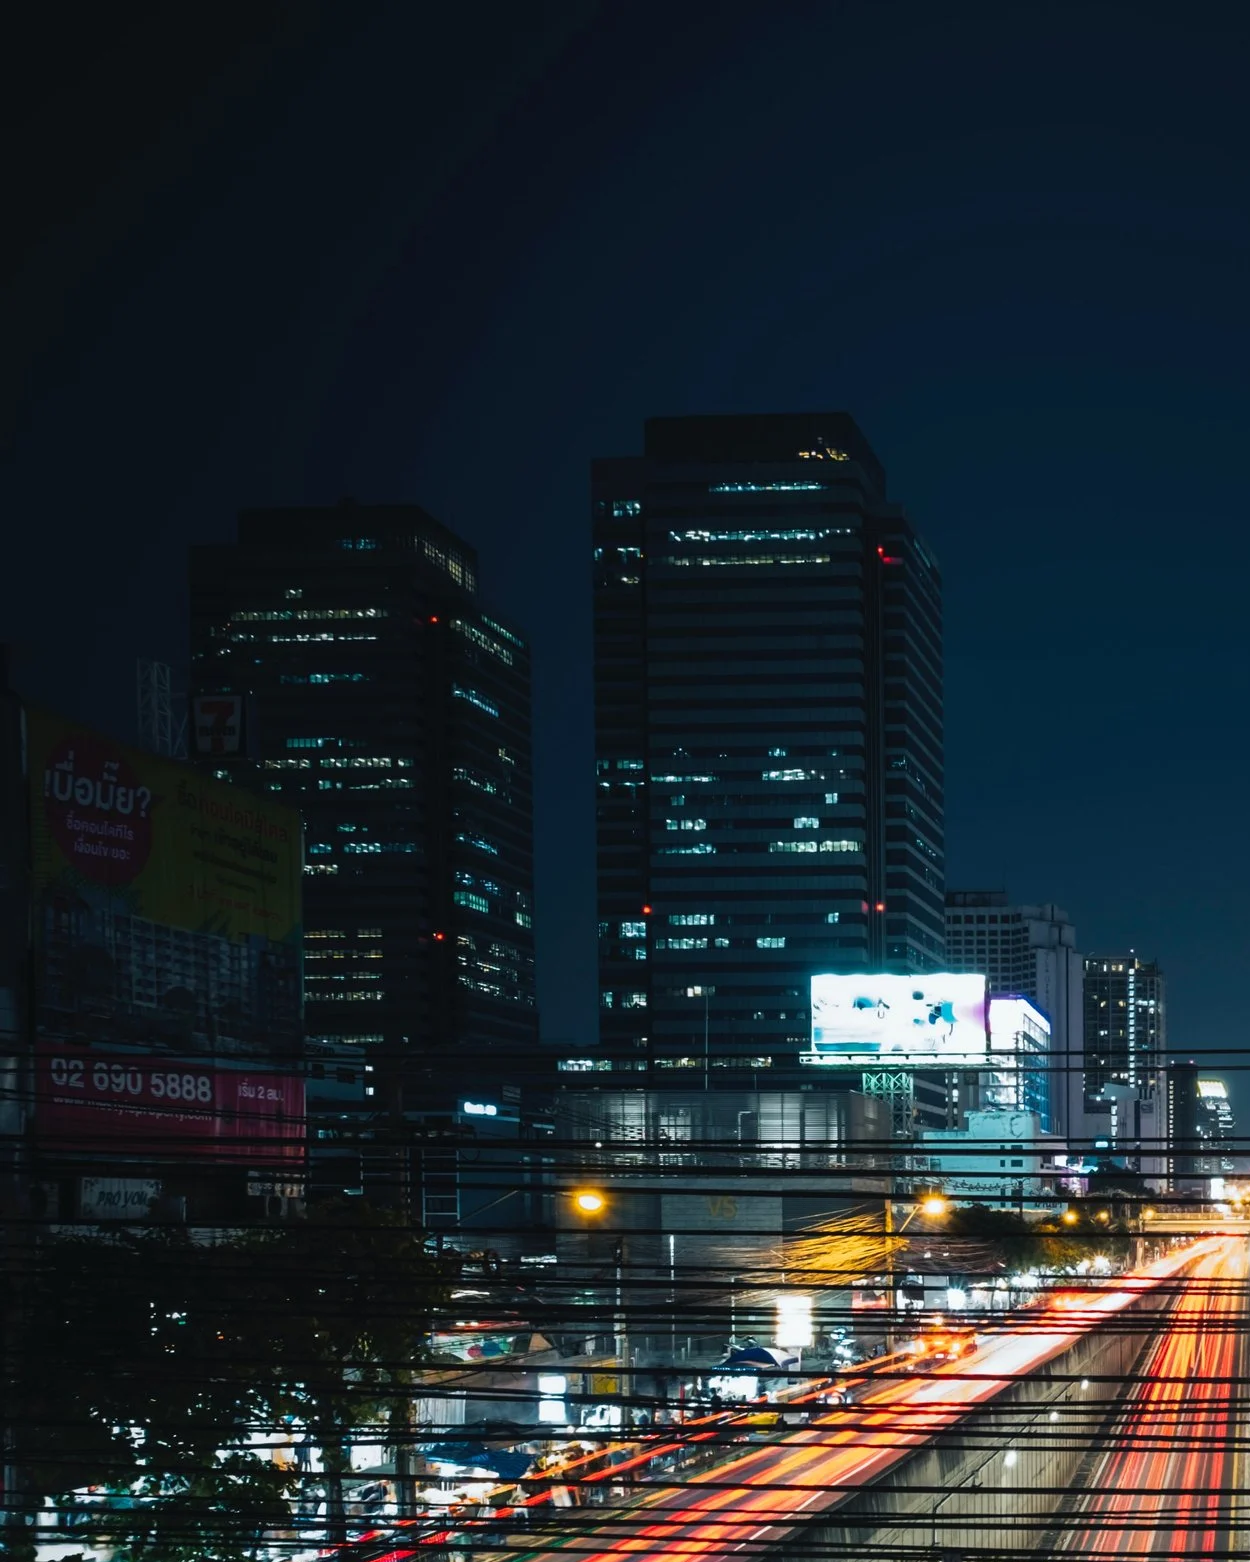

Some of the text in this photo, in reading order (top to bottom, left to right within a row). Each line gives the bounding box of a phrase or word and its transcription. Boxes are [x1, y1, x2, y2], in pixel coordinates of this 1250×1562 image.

[50, 1057, 213, 1103] 02 690 5888
[257, 1085, 265, 1099] 2
